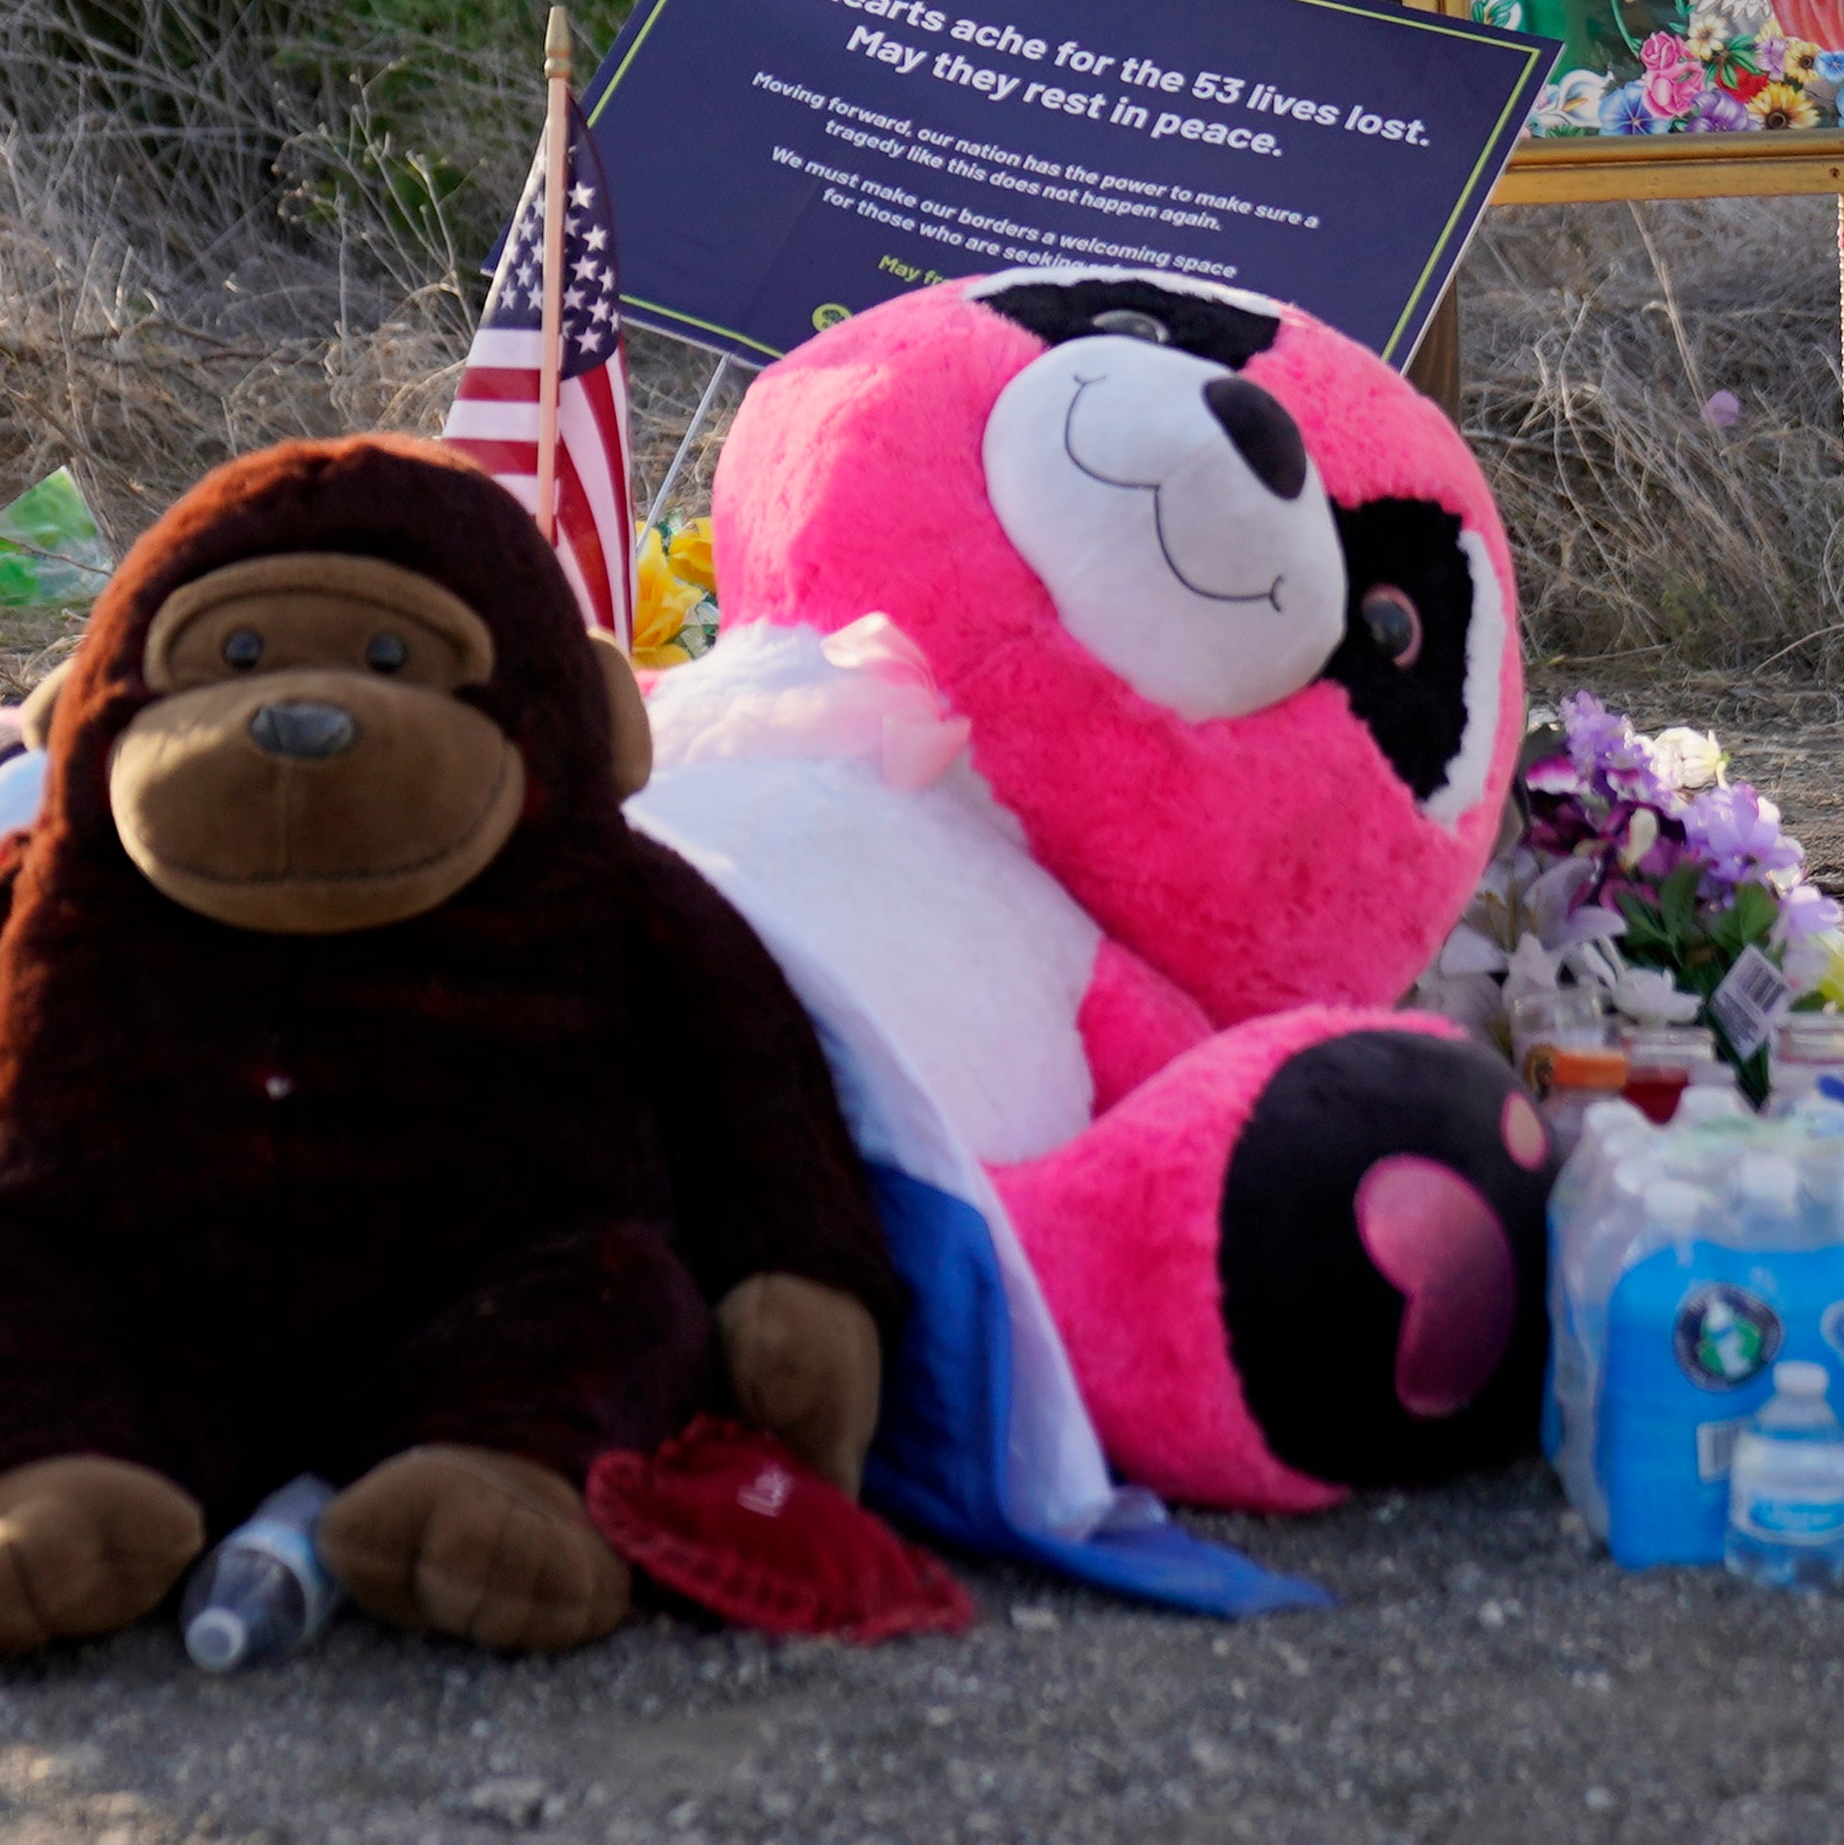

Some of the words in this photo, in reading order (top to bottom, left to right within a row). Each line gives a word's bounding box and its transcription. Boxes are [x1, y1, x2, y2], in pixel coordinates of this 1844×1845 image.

[846, 25, 927, 74] May
[932, 52, 1021, 101] they
[1022, 82, 1107, 119] rest
[1109, 96, 1149, 129] in
[1150, 112, 1282, 157] peace.
[950, 19, 1048, 60] ache
[1054, 41, 1112, 76] for
[1120, 57, 1185, 93] the
[1191, 71, 1246, 104] 53
[1246, 83, 1340, 125] lives
[1344, 105, 1430, 147] lost.
[752, 71, 826, 109] Moving
[827, 97, 912, 137] forward,
[917, 128, 955, 147] our
[954, 139, 1022, 167] nation
[1022, 154, 1062, 177] has
[1064, 164, 1099, 185] the
[1099, 175, 1168, 197] power
[1169, 185, 1193, 202] to
[1194, 192, 1252, 214] make
[1254, 205, 1303, 225] sure
[1303, 215, 1319, 229] a
[772, 145, 803, 169] We
[804, 161, 860, 188] must
[860, 180, 917, 208] make
[920, 200, 957, 219] our
[957, 208, 1040, 241] borders
[1041, 232, 1056, 245] a
[1059, 234, 1171, 270] welcoming
[1168, 255, 1237, 280] space
[825, 119, 906, 158] tragedy
[906, 145, 944, 169] like
[947, 158, 987, 181] this
[989, 171, 1041, 195] does
[1041, 185, 1080, 204] not
[1079, 187, 1158, 218] happen
[1159, 208, 1221, 231] again.
[822, 187, 855, 209] for
[856, 200, 916, 231] those
[919, 223, 963, 246] who
[964, 237, 1001, 256] are
[878, 255, 921, 282] May
